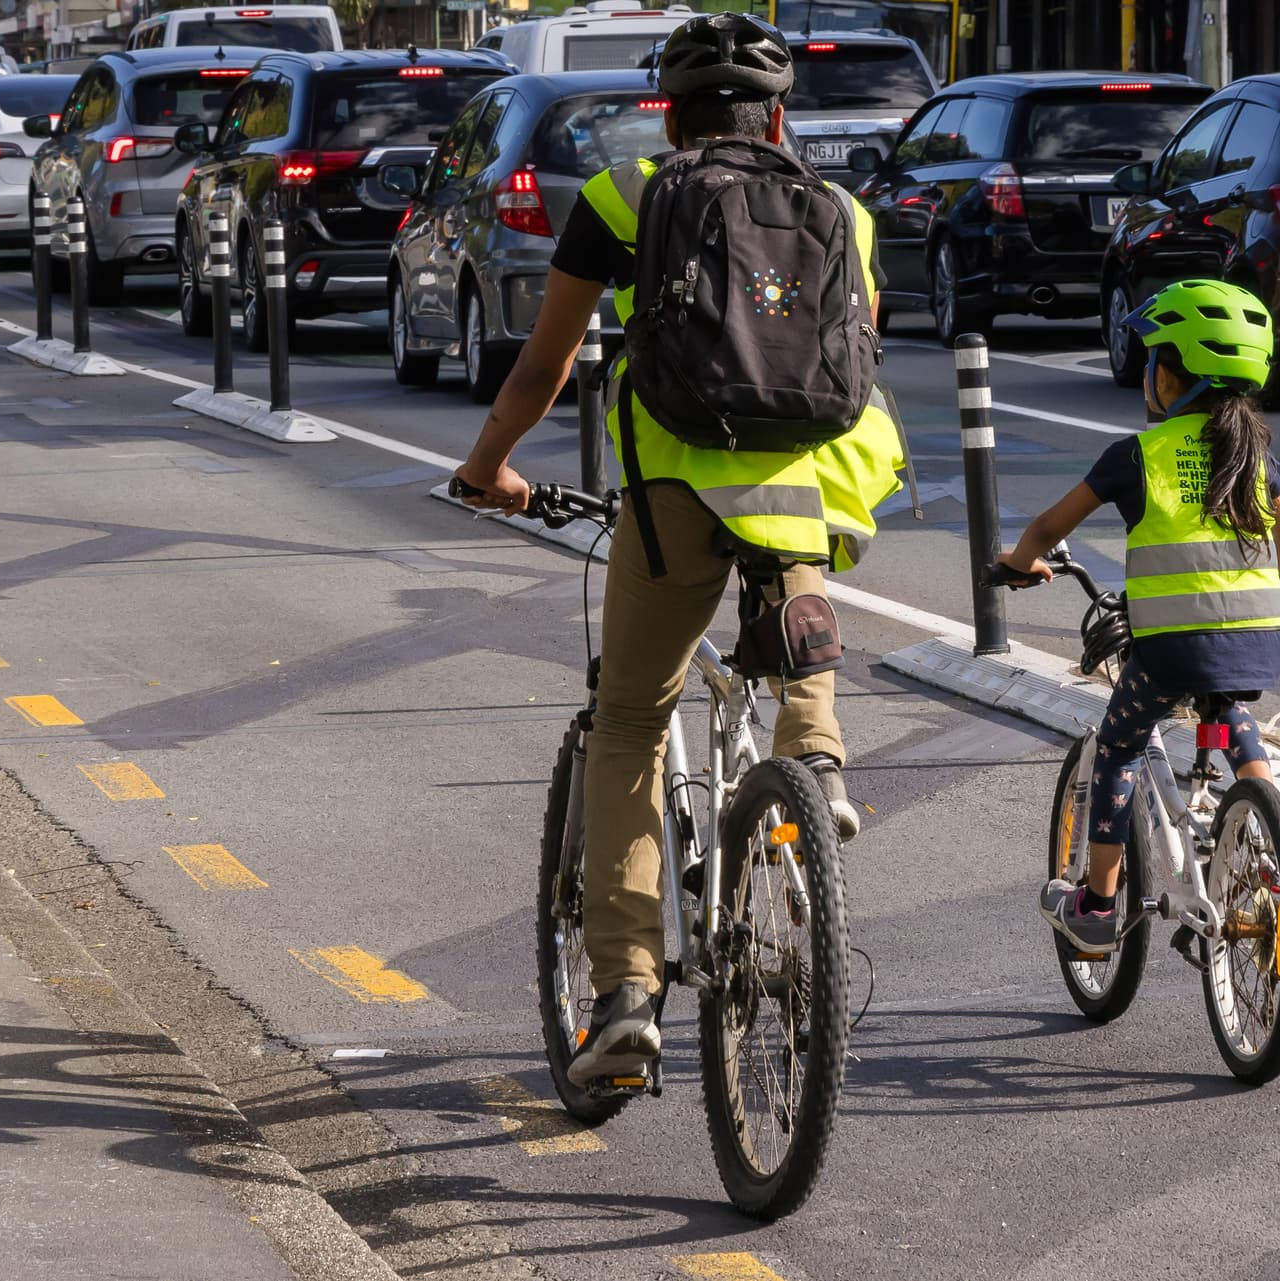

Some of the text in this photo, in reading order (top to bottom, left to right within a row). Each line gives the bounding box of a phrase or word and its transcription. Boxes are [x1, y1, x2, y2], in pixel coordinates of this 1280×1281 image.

[808, 144, 863, 160] NGJ12
[1175, 448, 1199, 457] Seen
[1176, 460, 1211, 471] HELM
[1190, 481, 1209, 493] VE
